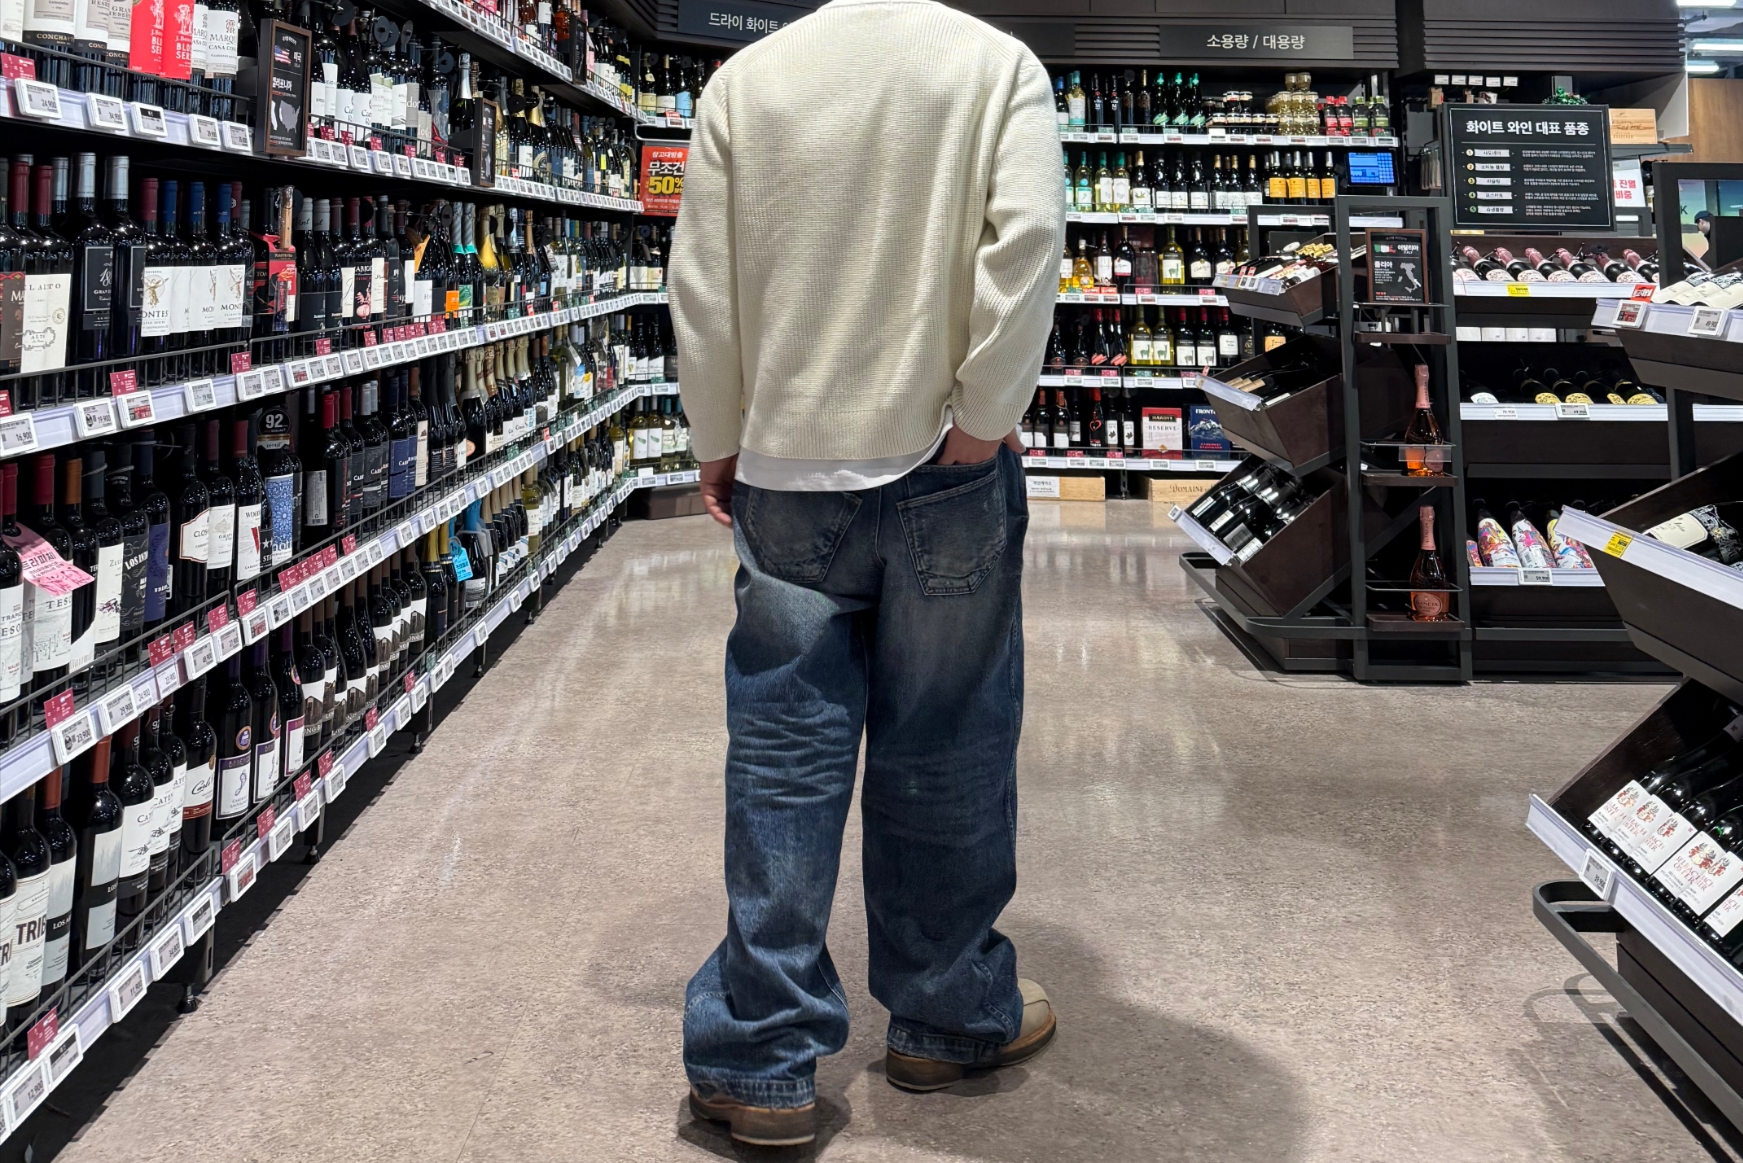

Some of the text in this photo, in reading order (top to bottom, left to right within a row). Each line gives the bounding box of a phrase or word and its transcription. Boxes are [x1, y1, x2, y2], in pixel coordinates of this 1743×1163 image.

[709, 12, 779, 34] 드라이 화이트
[1206, 34, 1305, 50] 소용량 / 대용량
[1466, 120, 1590, 136] 화이트 와인 대표 품종
[647, 160, 686, 176] 무조건
[265, 413, 284, 429] 92
